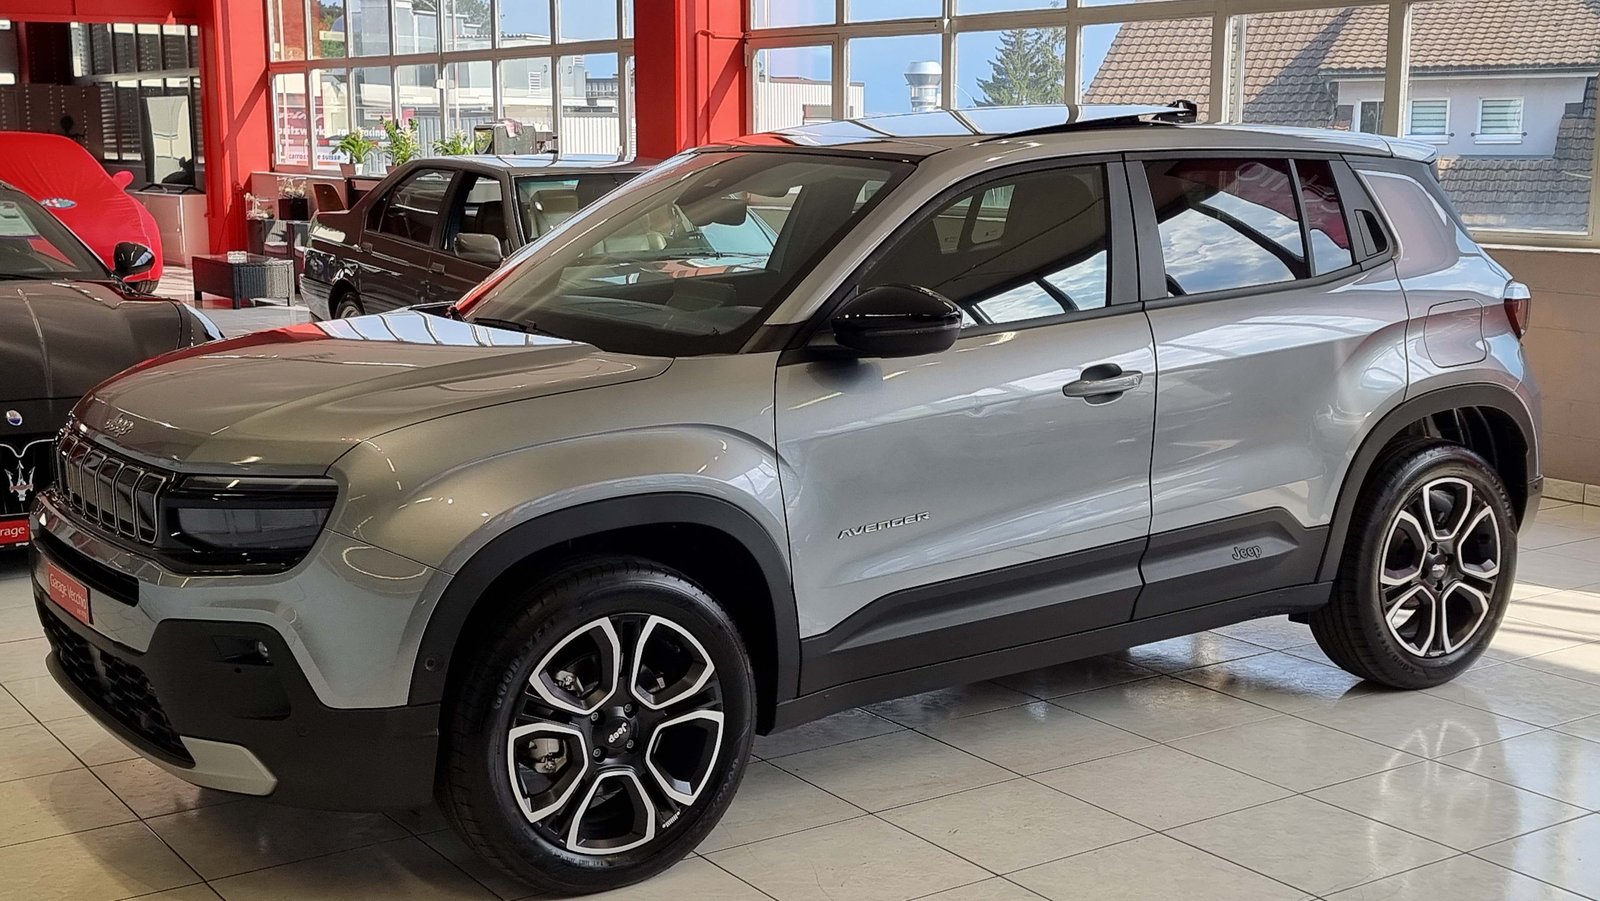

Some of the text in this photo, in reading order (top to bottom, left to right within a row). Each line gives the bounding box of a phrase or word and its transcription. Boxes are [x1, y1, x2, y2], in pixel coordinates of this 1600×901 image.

[837, 511, 931, 540] AVENGER
[1231, 545, 1262, 561] Jeep
[50, 573, 87, 610] Garage Vecchio
[608, 722, 627, 743] Jeep
